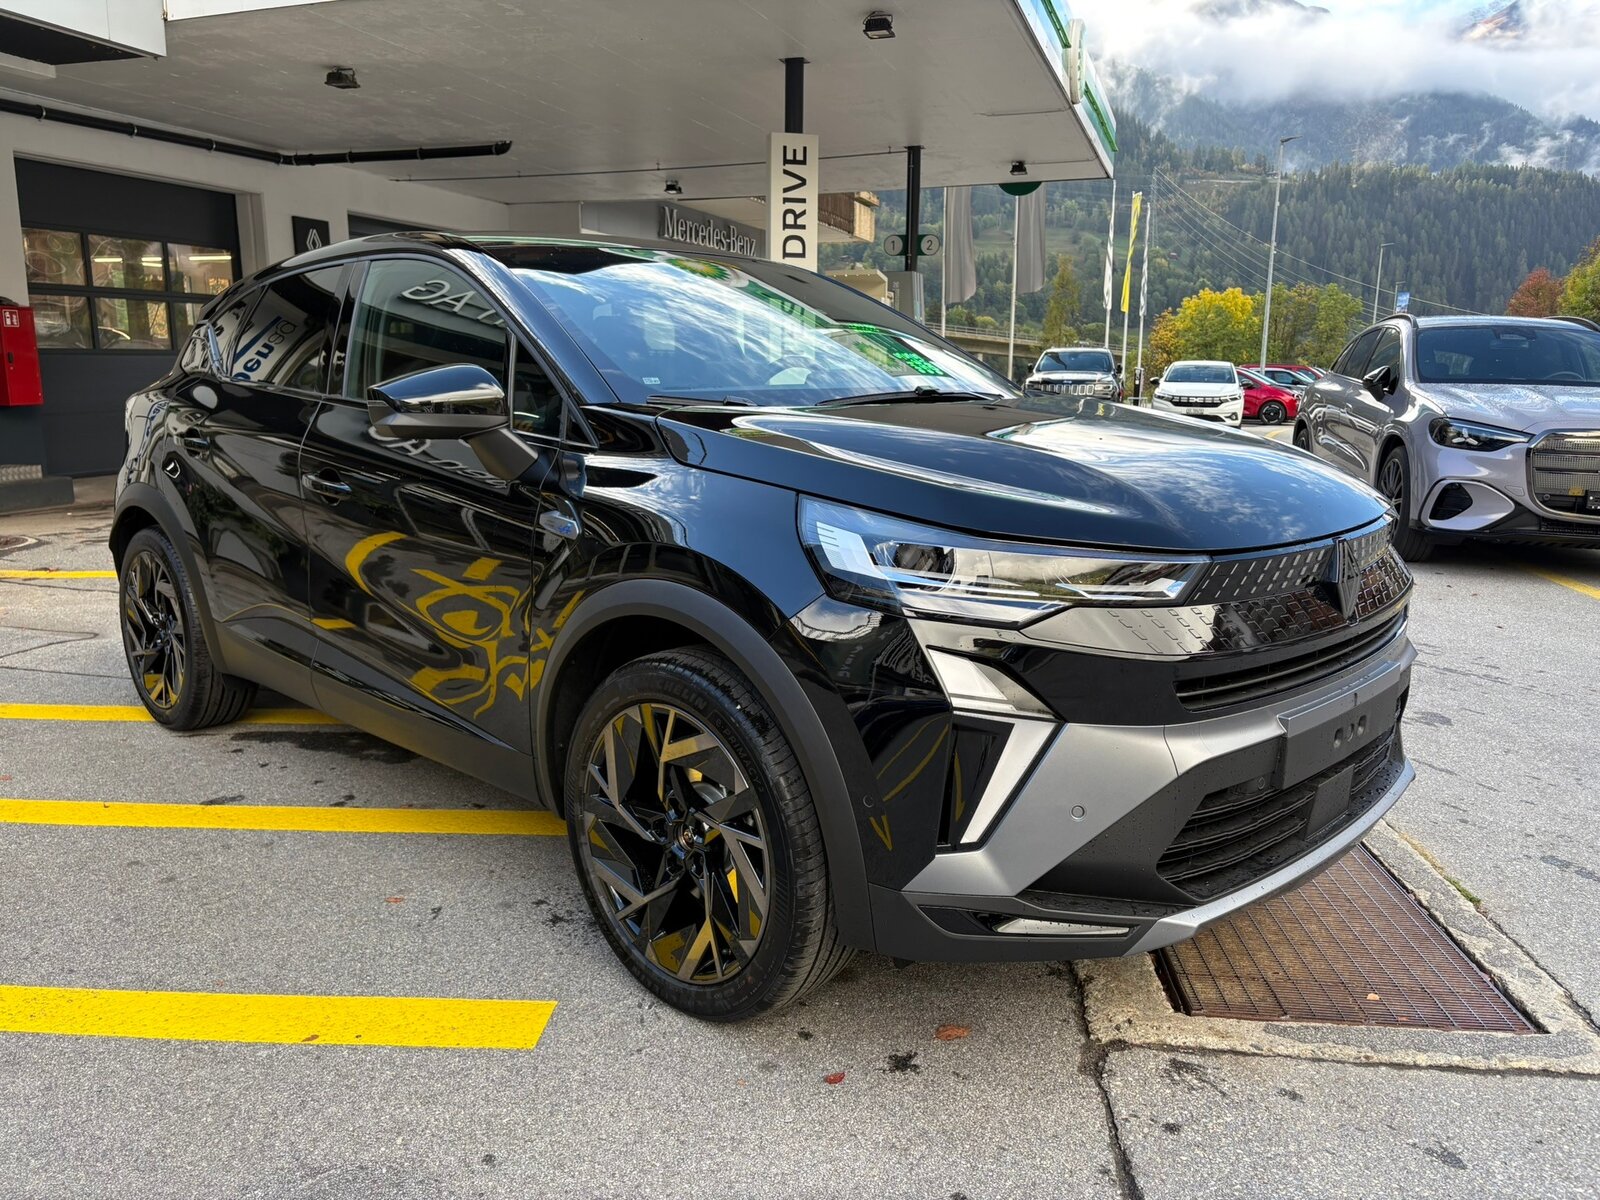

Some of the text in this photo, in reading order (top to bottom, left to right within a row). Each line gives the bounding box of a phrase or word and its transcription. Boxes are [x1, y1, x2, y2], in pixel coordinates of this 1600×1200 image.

[783, 145, 807, 259] DRIVE
[663, 206, 756, 257] Mercedes-Benz
[891, 240, 895, 251] 1
[926, 239, 933, 251] 2
